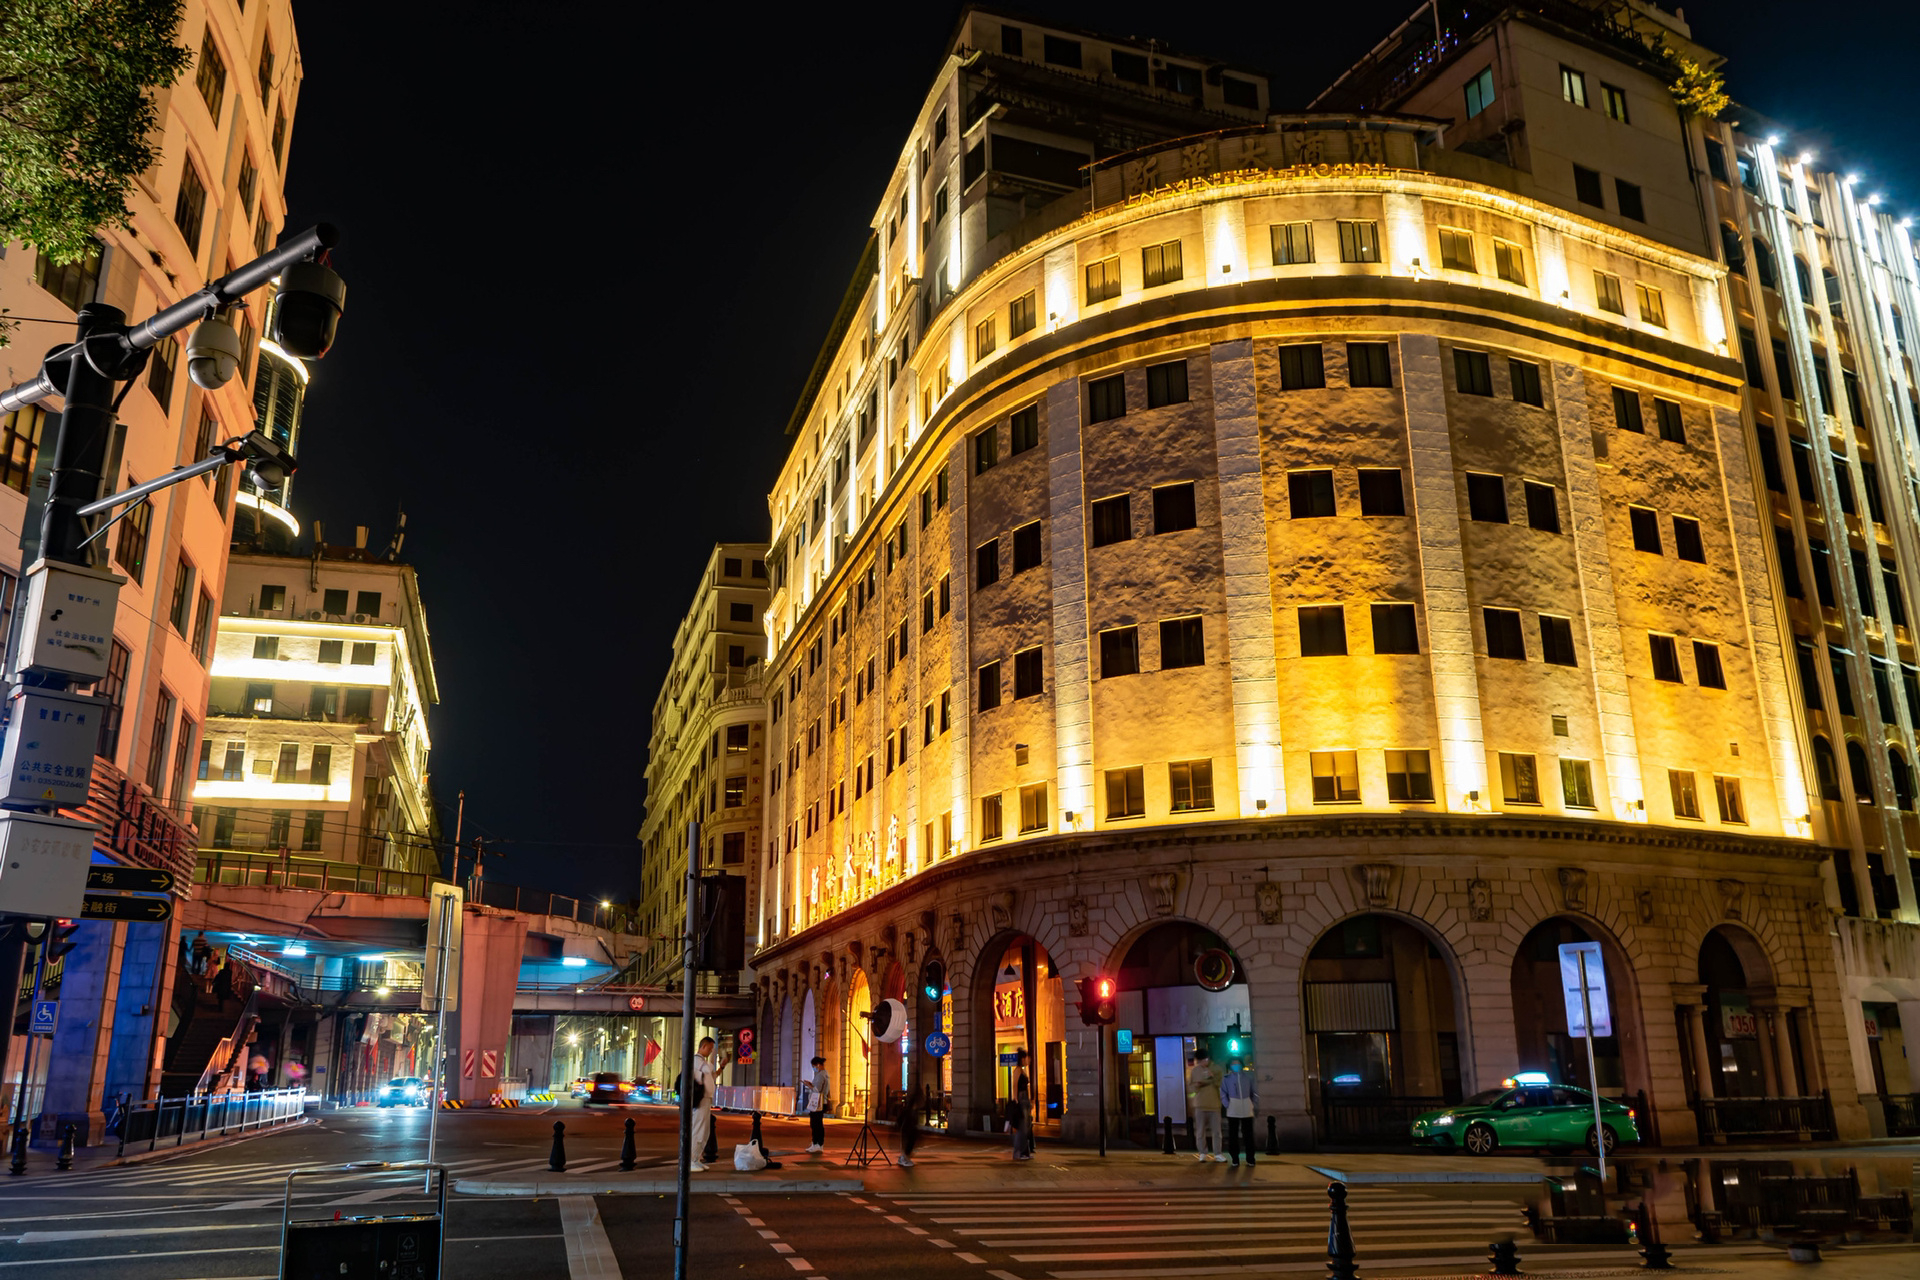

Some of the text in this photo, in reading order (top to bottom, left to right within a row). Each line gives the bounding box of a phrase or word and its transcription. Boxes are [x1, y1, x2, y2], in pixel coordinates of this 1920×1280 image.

[1163, 165, 1283, 196] XINHUA
[1290, 163, 1391, 179] HOTEL
[67, 593, 101, 606] 智慧广州
[55, 629, 105, 645] 社会治安视频
[39, 707, 87, 726] 智慧广州
[20, 759, 87, 780] 公共安全视频
[87, 871, 115, 885] 广场
[748, 890, 756, 924] HOTEL
